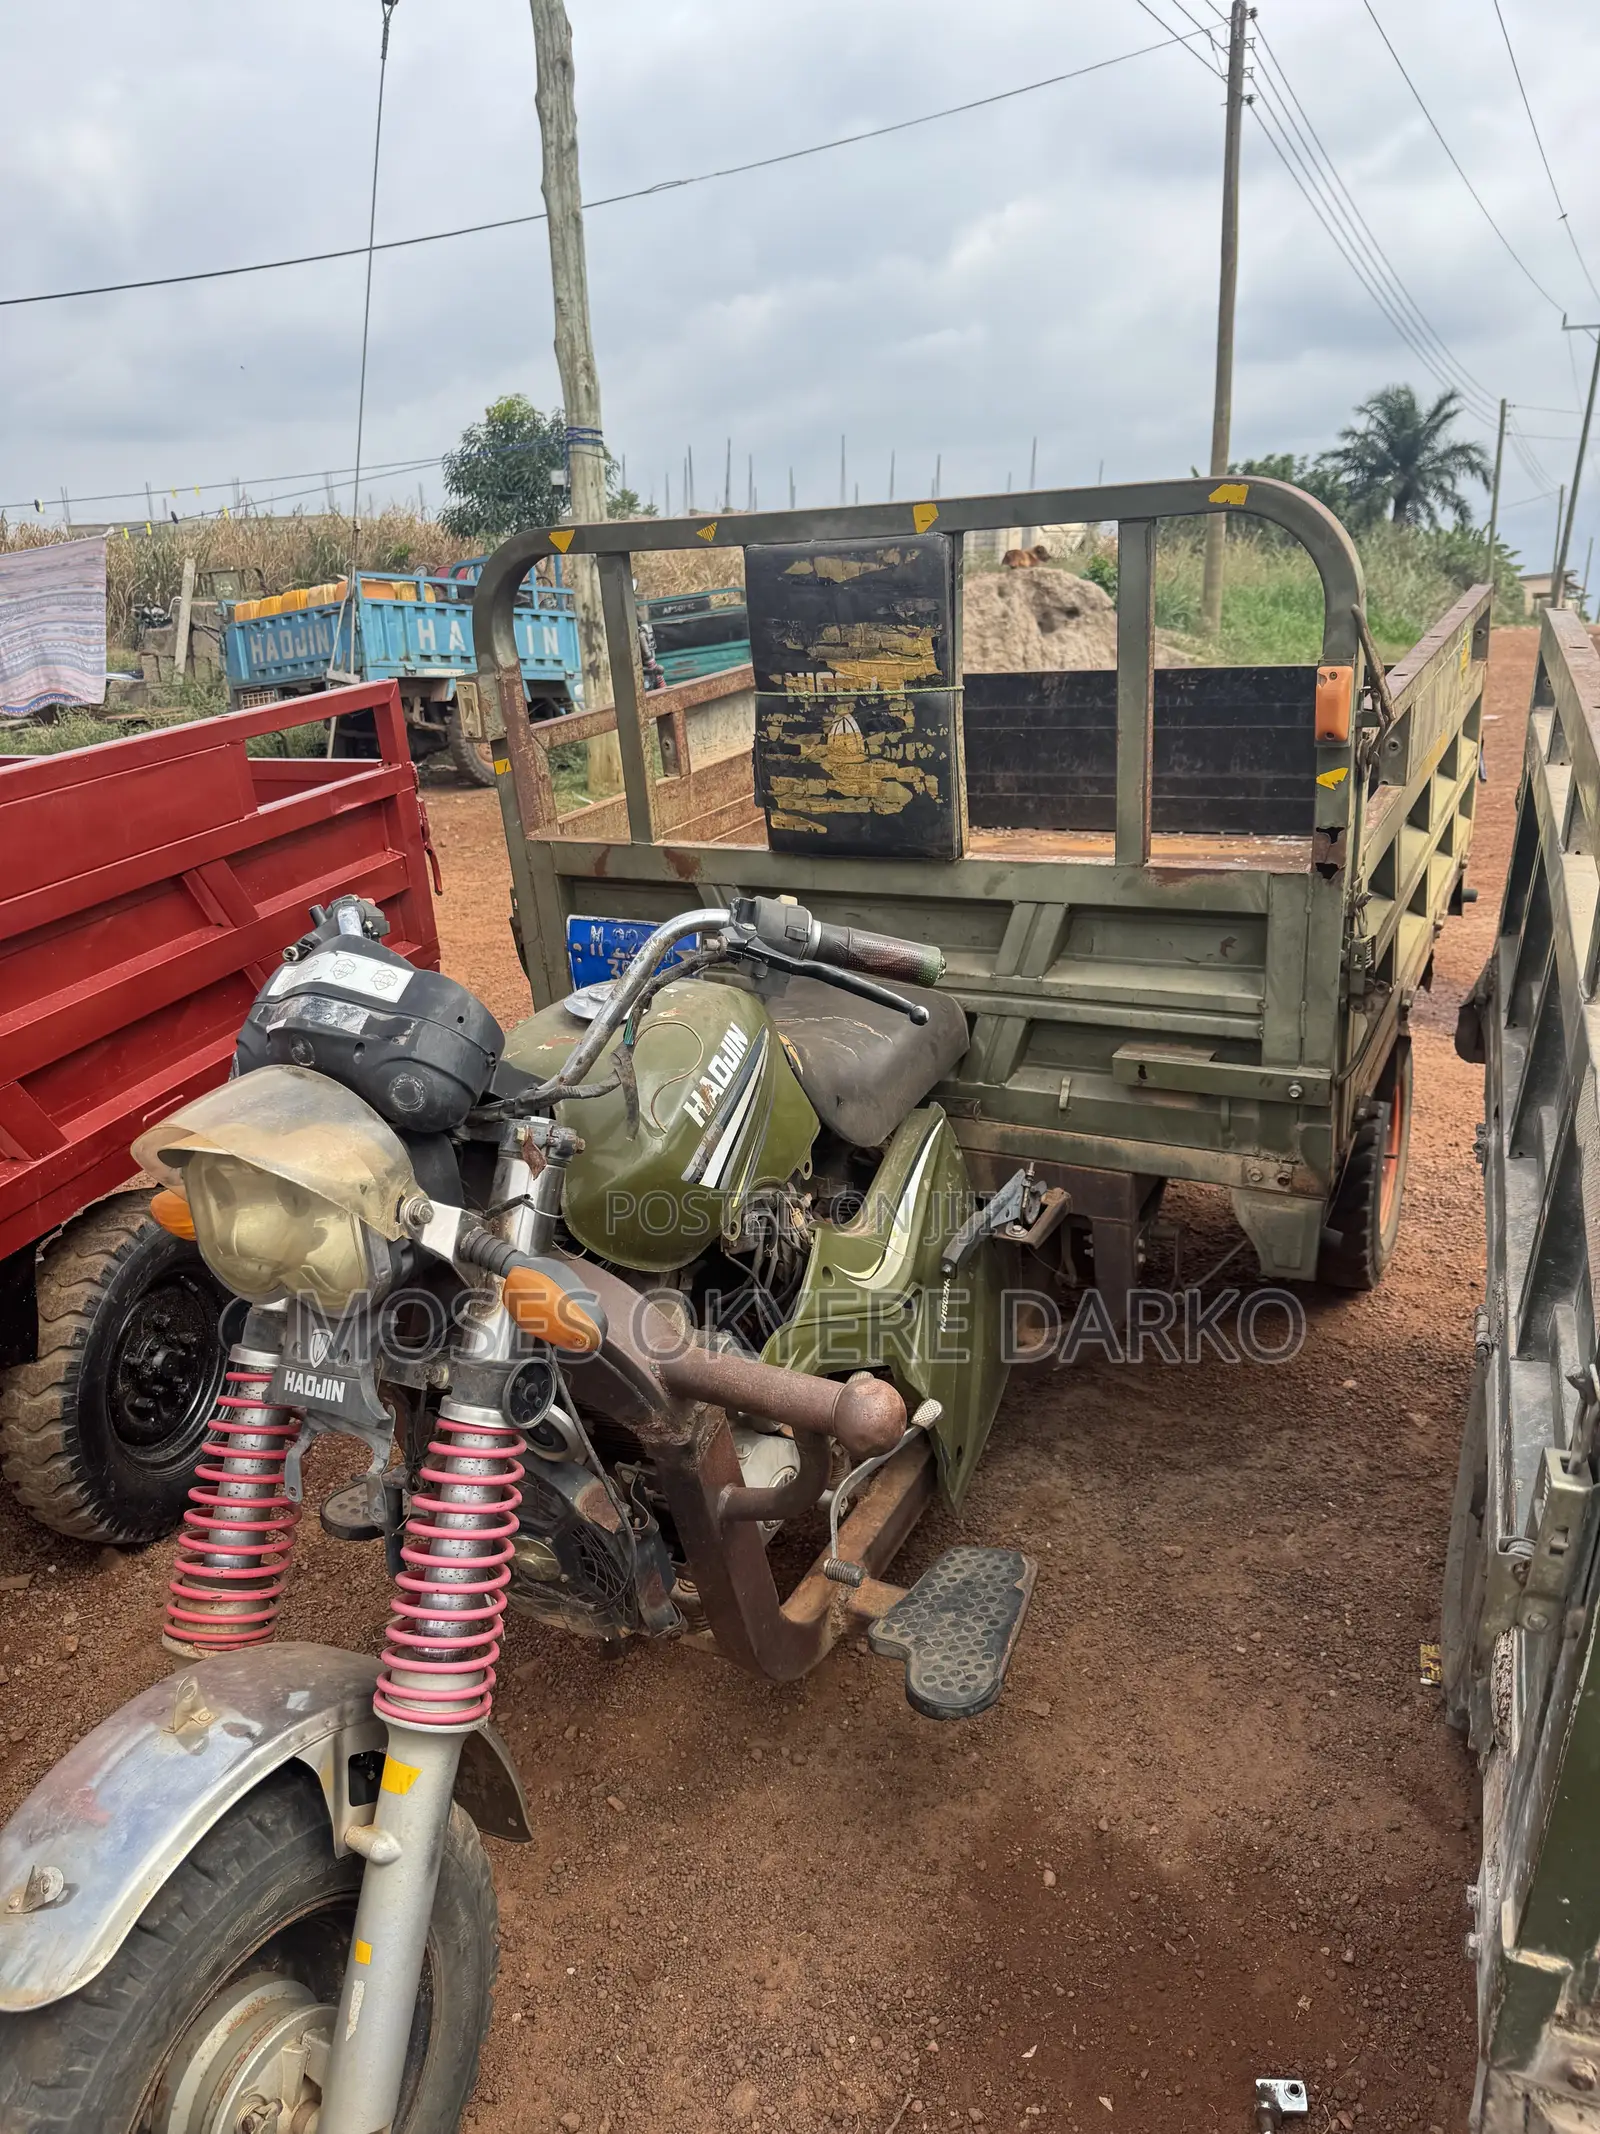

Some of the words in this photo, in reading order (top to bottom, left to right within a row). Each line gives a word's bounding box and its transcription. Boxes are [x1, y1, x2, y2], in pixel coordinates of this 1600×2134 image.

[249, 623, 330, 664] HAOJIN
[418, 617, 559, 656] HAIN
[682, 1021, 748, 1128] HAOJIN
[284, 1370, 346, 1403] HAOJIN
